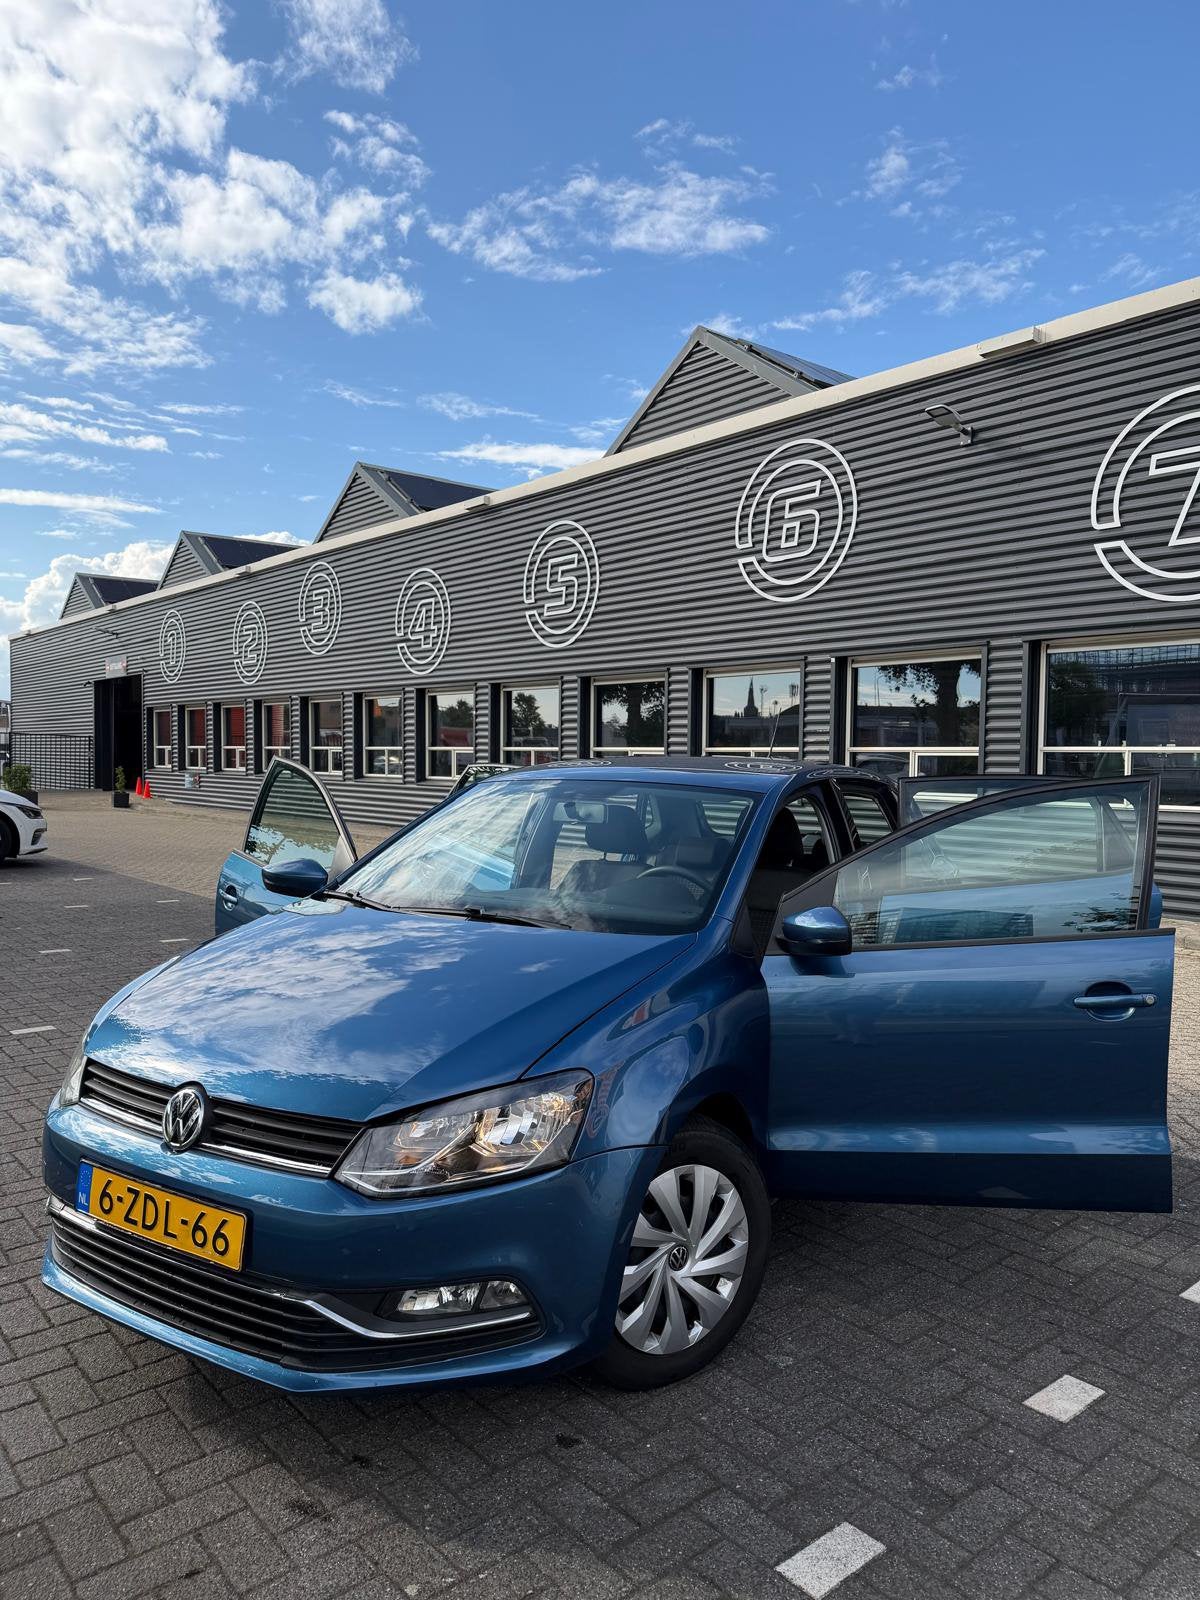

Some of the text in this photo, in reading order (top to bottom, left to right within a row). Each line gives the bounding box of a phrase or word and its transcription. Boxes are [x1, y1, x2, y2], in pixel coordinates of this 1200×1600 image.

[763, 480, 822, 562] 6
[543, 553, 578, 617] 5
[311, 588, 331, 633] 3
[408, 598, 438, 648] 4
[168, 631, 177, 664] 1
[243, 624, 258, 664] 2
[78, 1191, 89, 1207] NL
[99, 1178, 230, 1257] 6-ZDL-66
